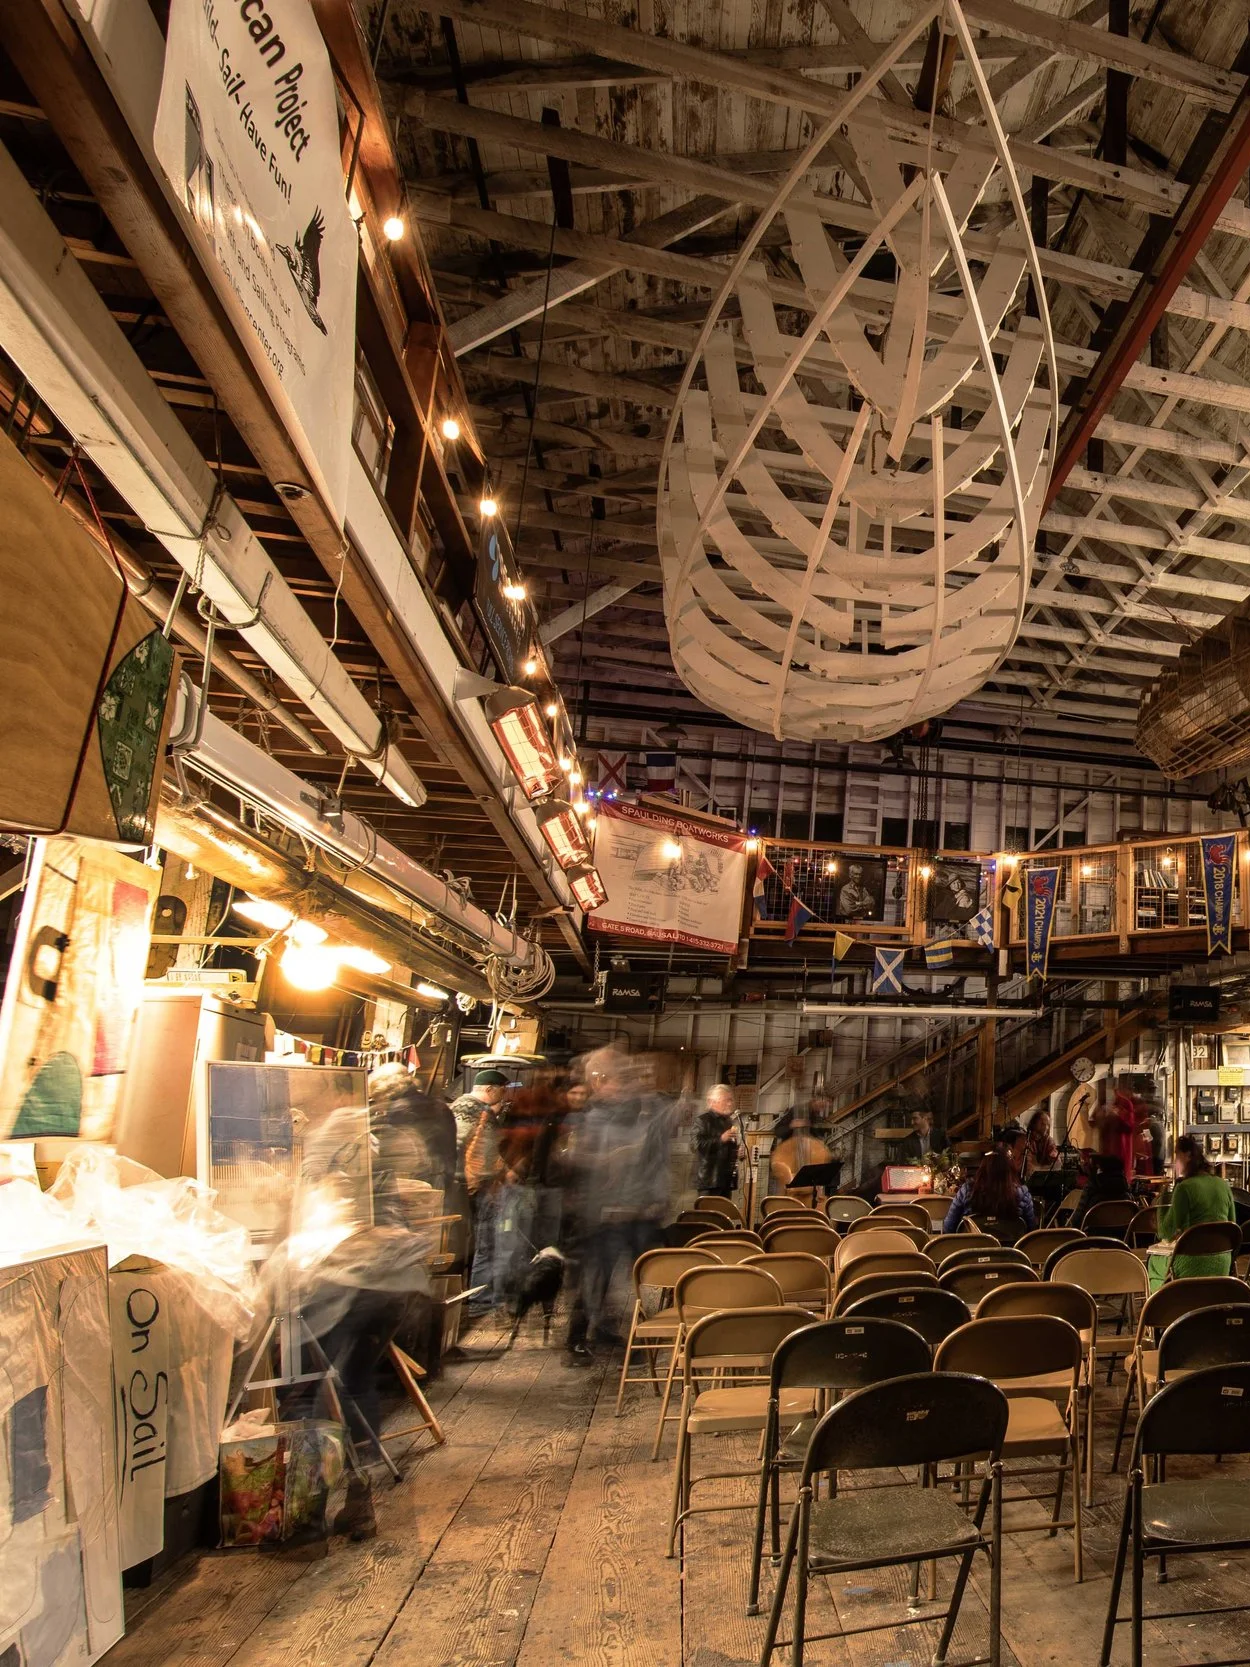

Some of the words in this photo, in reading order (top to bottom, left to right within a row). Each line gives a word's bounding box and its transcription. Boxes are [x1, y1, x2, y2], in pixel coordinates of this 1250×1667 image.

[234, 0, 286, 68] can
[274, 62, 311, 163] Project
[203, 0, 219, 50] uild-
[239, 102, 267, 162] Have
[268, 152, 292, 205] Fun!
[237, 249, 251, 283] and
[251, 272, 276, 328] Sailing
[275, 315, 306, 377] Programs
[621, 805, 675, 827] SPAULDING
[676, 820, 729, 843] BOATWORKS
[1212, 866, 1226, 889] 2018
[602, 922, 619, 931] GATE
[1034, 897, 1047, 920] 2021
[612, 988, 641, 997] RAMSA
[1189, 1000, 1213, 1008] RAMSA
[126, 1288, 160, 1354] On
[129, 1369, 169, 1482] Sail
